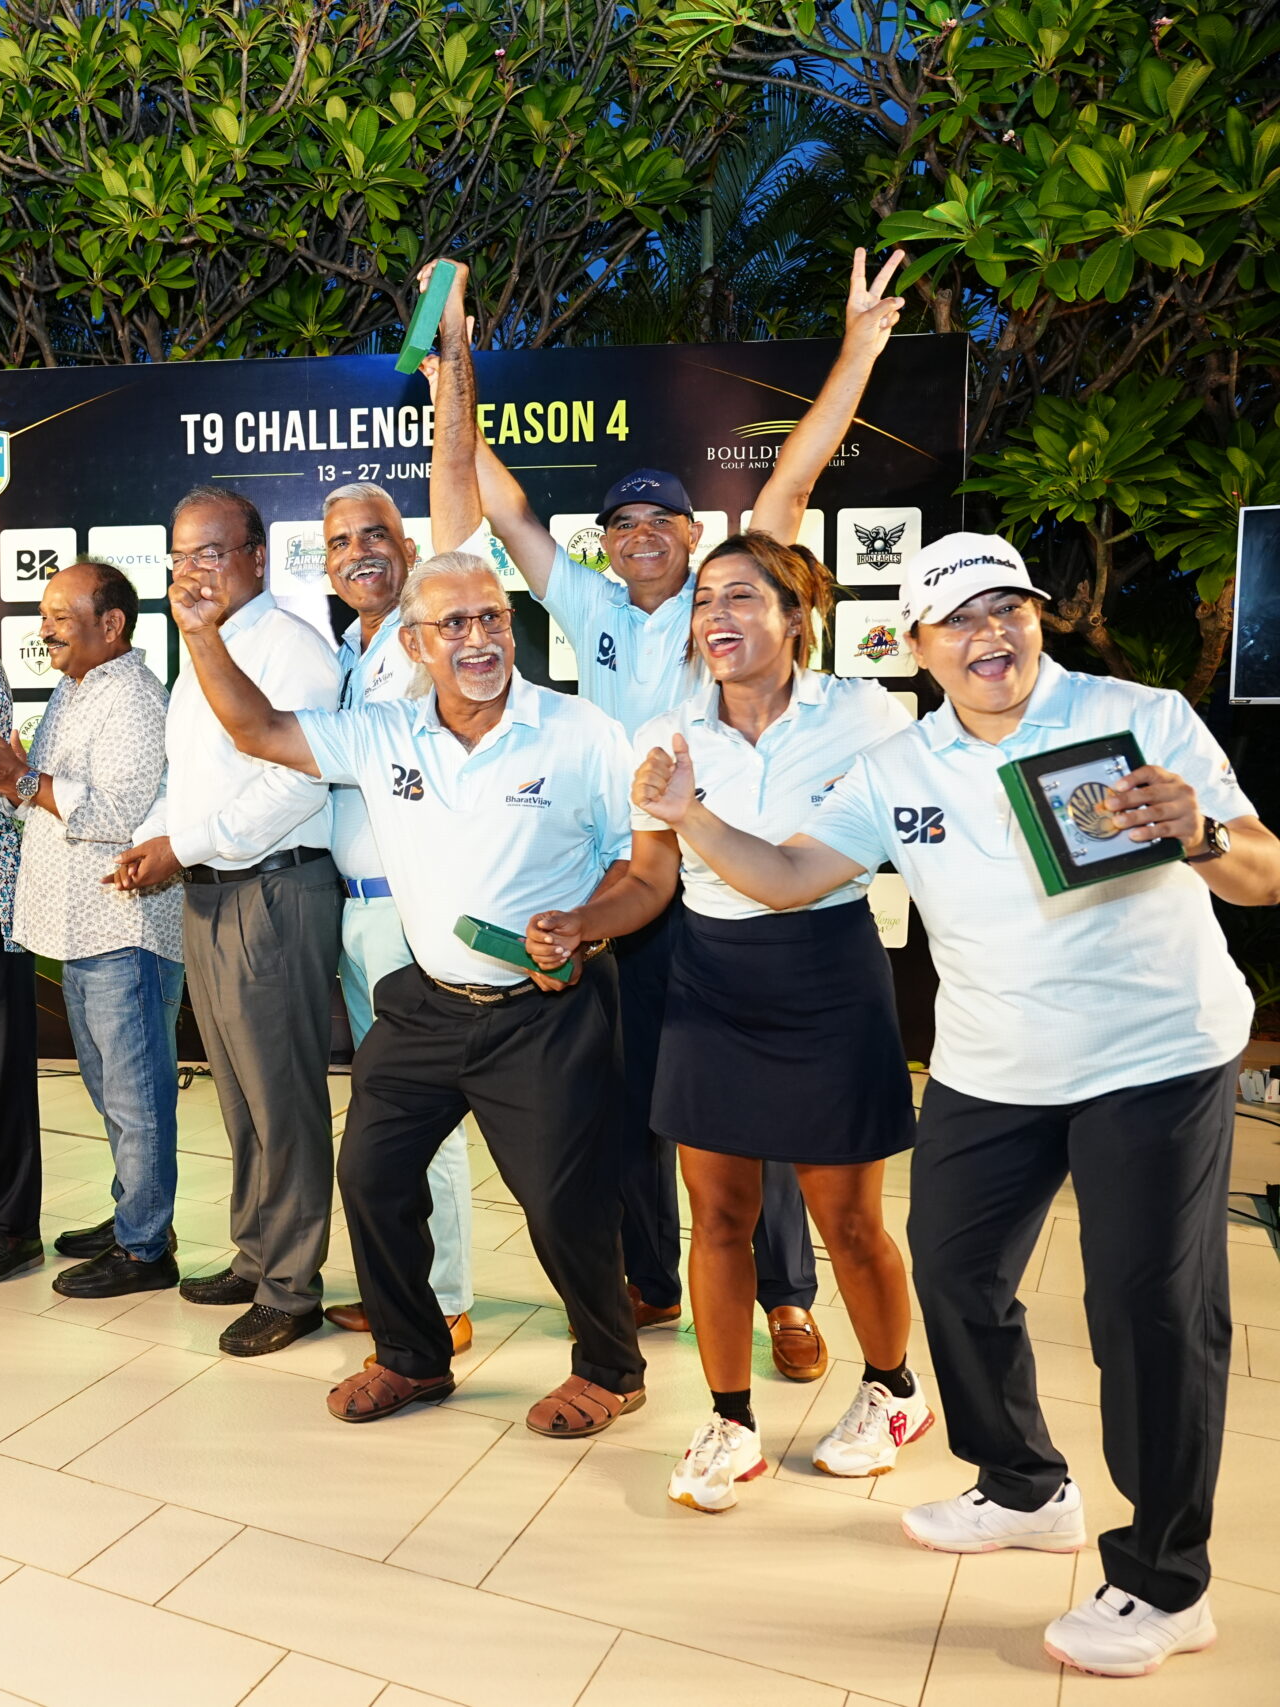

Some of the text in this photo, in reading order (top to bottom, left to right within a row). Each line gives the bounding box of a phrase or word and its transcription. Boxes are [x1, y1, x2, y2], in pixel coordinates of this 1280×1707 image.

[180, 400, 629, 455] T9 CHALLENGE EASON 4
[707, 445, 783, 461] BOULDE
[317, 464, 336, 482] 13
[357, 463, 381, 481] 27
[721, 461, 745, 470] GOLF
[748, 461, 769, 469] AND
[828, 459, 846, 467] LUB
[570, 531, 600, 550] PAR-TIM
[106, 555, 161, 565] OVOTEL
[285, 554, 326, 570] FAIRWA
[923, 555, 1018, 587] TaylorMade
[505, 795, 553, 808] BharatVijay
